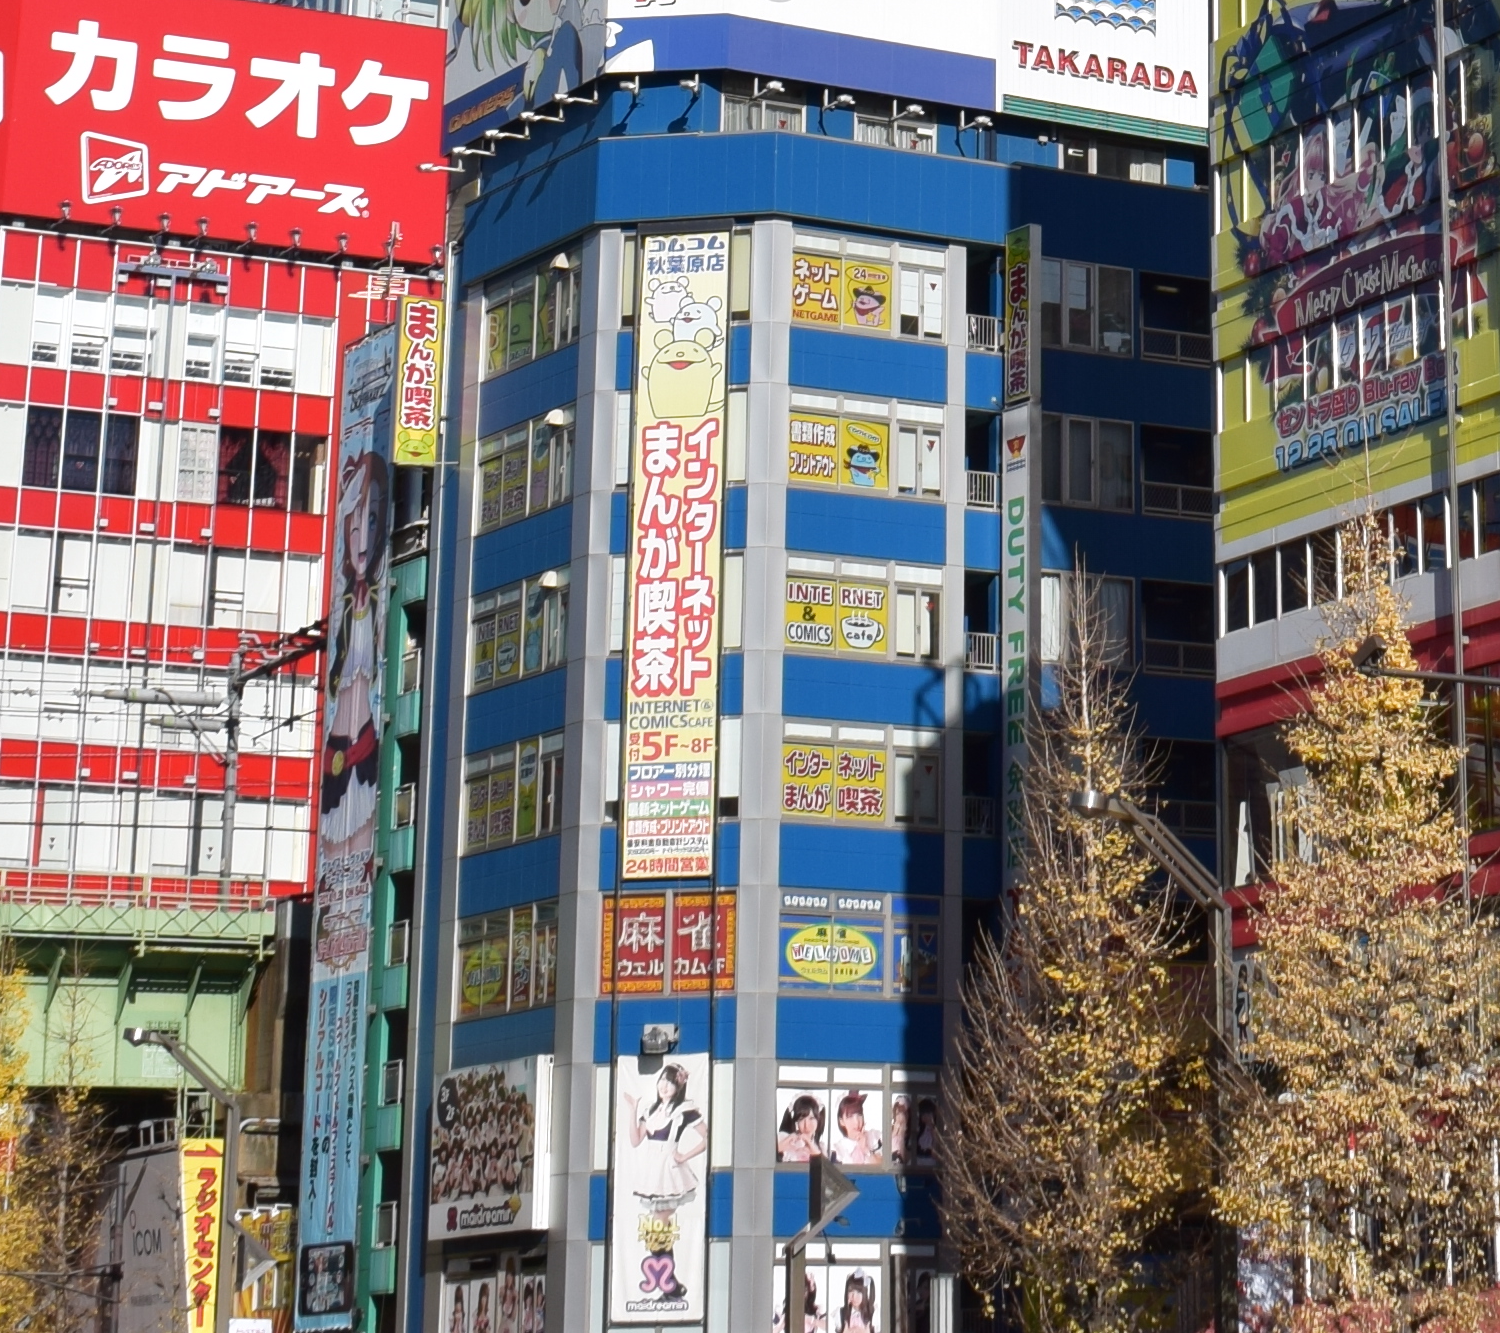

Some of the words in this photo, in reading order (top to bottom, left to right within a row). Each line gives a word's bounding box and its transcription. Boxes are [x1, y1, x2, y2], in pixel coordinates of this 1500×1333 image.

[43, 17, 430, 147] カラオケ
[1011, 39, 1200, 99] TAKARADA
[449, 83, 519, 134] GAMERS
[155, 160, 368, 218] アドアーズ
[646, 234, 726, 254] コムコム
[645, 252, 726, 275] 秋葉原店
[792, 258, 840, 284] ネット
[852, 267, 867, 281] 24
[791, 283, 838, 311] ゲーム
[1293, 287, 1341, 329] Merry
[792, 309, 839, 323] NETGAME
[1006, 264, 1028, 393] まんが喫茶
[401, 300, 440, 432] まんが喫茶
[1362, 365, 1422, 408] Blu-ray
[790, 420, 837, 448] 書類作成
[1343, 413, 1376, 447] ON
[789, 449, 837, 480] プリントアウト
[632, 419, 680, 698] まんが喫茶
[678, 418, 720, 696] インターネット
[1006, 494, 1027, 616] DUTY
[803, 604, 818, 624] &
[787, 623, 833, 647] COMICS
[844, 628, 876, 641] cafe
[1006, 632, 1027, 747] FREE
[628, 698, 701, 716] INTERNET
[628, 714, 688, 731] COMICS
[687, 717, 714, 729] CAFE
[629, 762, 711, 781] フロアー別分煙
[629, 780, 710, 799] シャワー完備
[625, 856, 710, 875] 24時間営業
[791, 942, 873, 966] WELCOME
[637, 1213, 681, 1233] No.1
[191, 1167, 218, 1328] ラジオセンター
